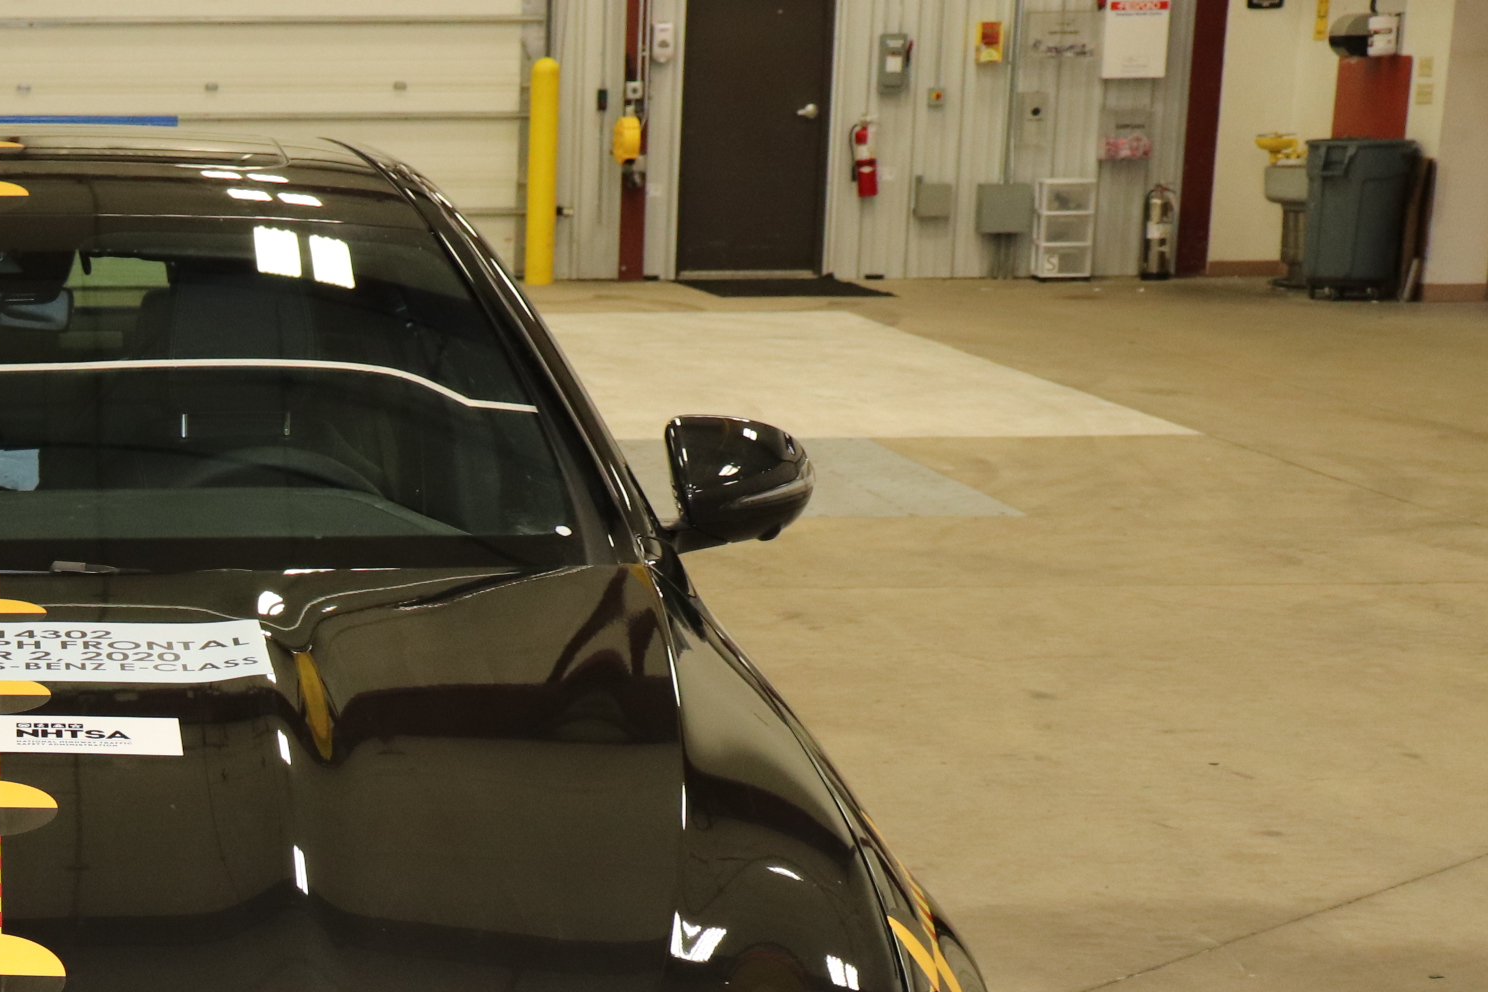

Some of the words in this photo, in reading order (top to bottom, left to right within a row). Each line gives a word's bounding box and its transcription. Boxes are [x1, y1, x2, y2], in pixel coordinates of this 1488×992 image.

[60, 637, 250, 651] FRONTAL
[28, 651, 63, 662] 2,
[80, 651, 182, 662] 2020
[119, 656, 259, 672] E-CLASS
[16, 729, 131, 740] NHTSA
